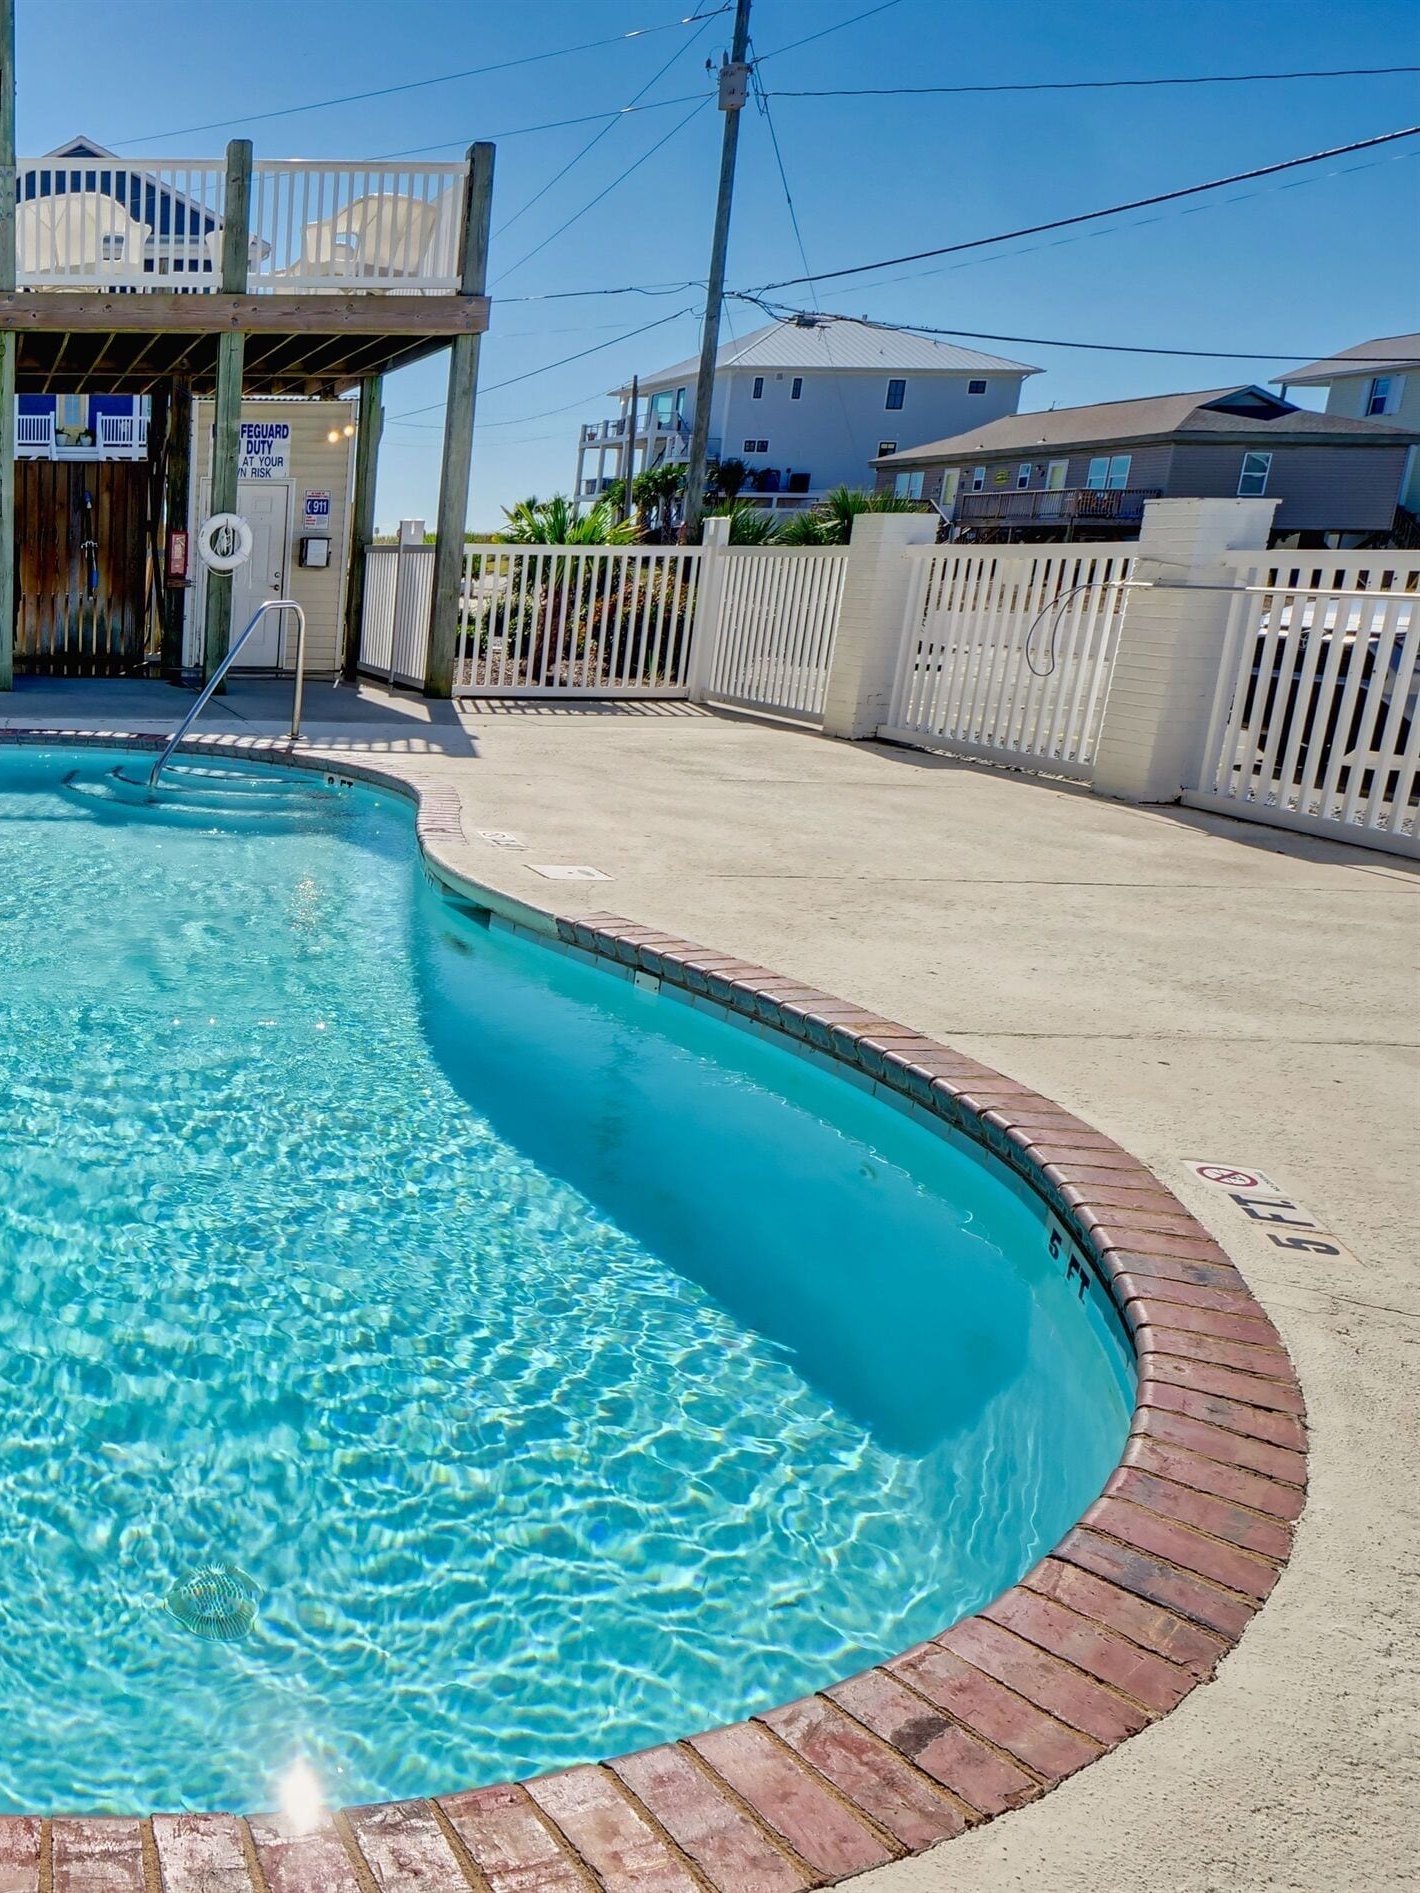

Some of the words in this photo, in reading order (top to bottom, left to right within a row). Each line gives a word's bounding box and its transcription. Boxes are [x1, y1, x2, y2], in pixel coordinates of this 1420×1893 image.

[241, 424, 289, 439] FEGUARD
[246, 440, 273, 454] DUTY
[242, 457, 254, 466] AT
[259, 457, 284, 467] YOUR
[251, 468, 271, 478] RISK
[313, 501, 327, 513] 911
[1228, 1193, 1316, 1227] FT.
[1048, 1228, 1062, 1260] 5
[1266, 1233, 1340, 1255] 5
